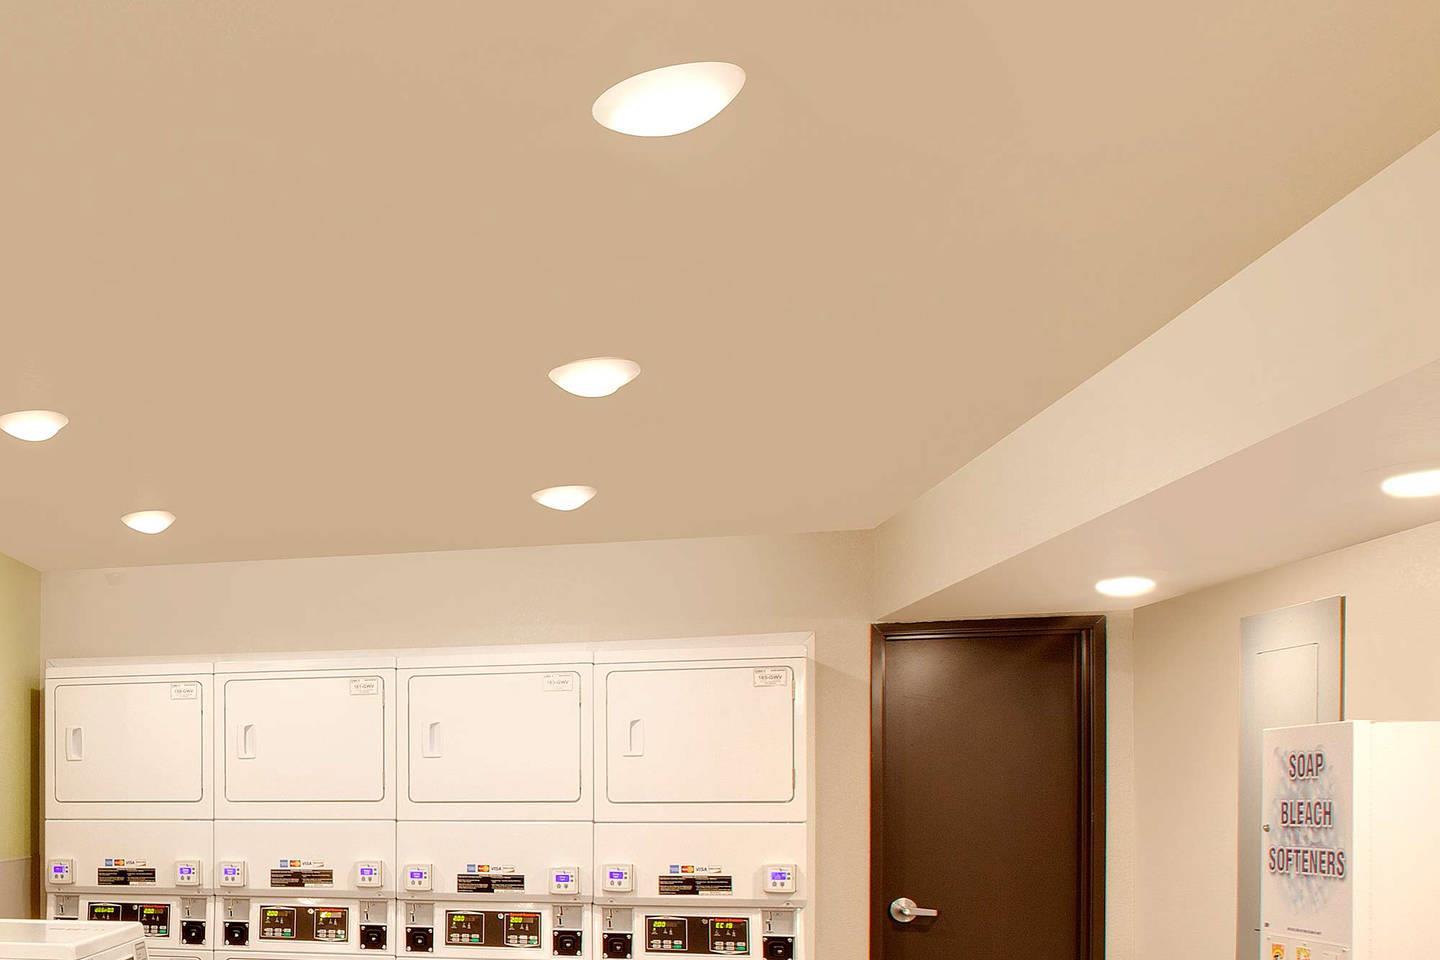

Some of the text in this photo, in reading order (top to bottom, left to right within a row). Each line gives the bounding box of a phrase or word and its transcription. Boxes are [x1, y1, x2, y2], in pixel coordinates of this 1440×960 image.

[1288, 752, 1325, 778] SOAP
[1280, 800, 1332, 826] BLEACH
[1268, 847, 1345, 876] SOFTENERS
